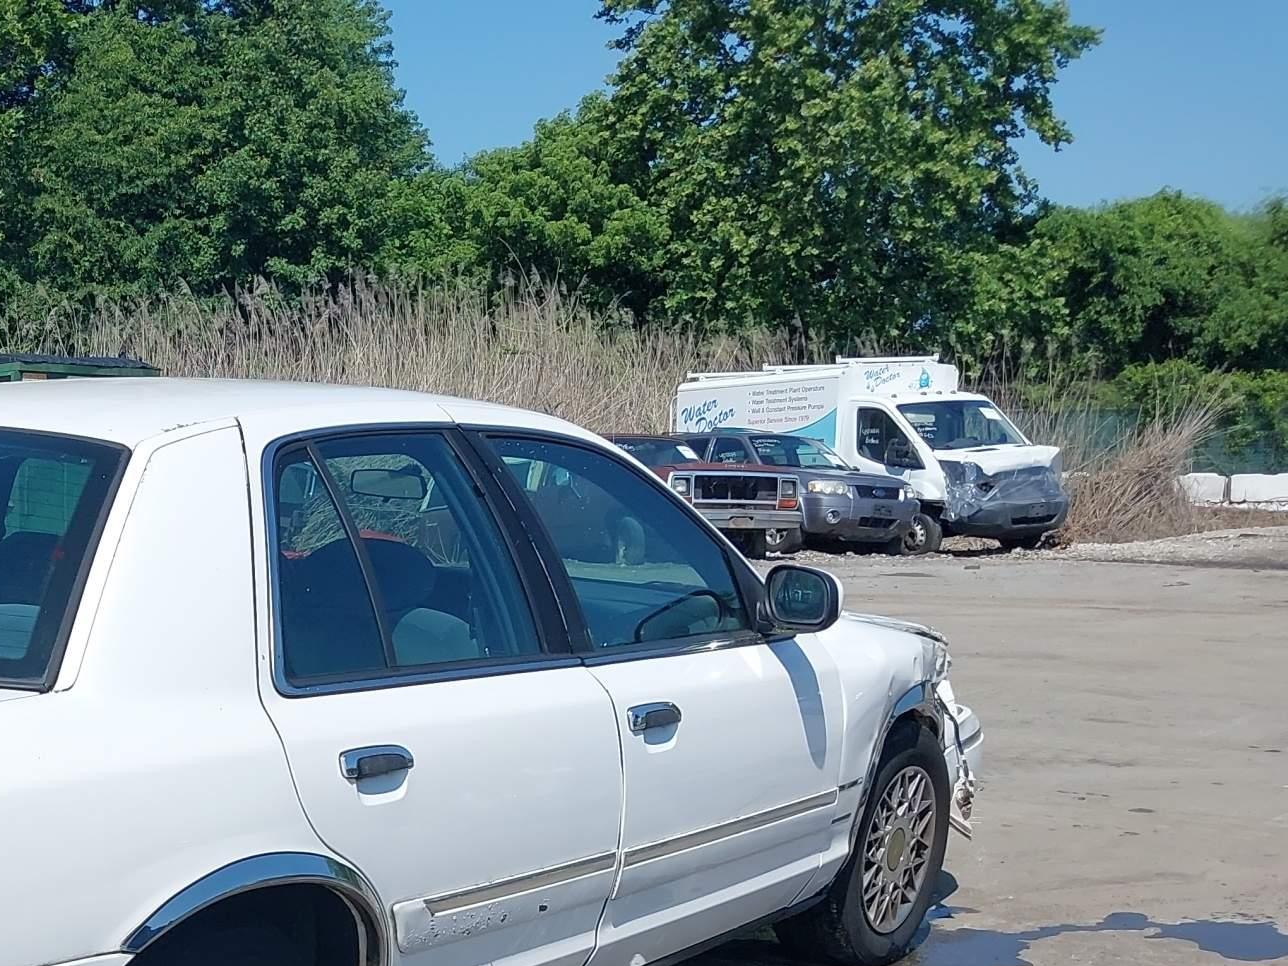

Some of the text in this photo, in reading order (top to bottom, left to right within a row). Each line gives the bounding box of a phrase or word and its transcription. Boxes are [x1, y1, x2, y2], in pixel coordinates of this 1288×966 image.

[864, 365, 889, 380] Water
[874, 372, 900, 387] Doctor
[681, 399, 718, 424] Water
[695, 407, 735, 433] Doctor
